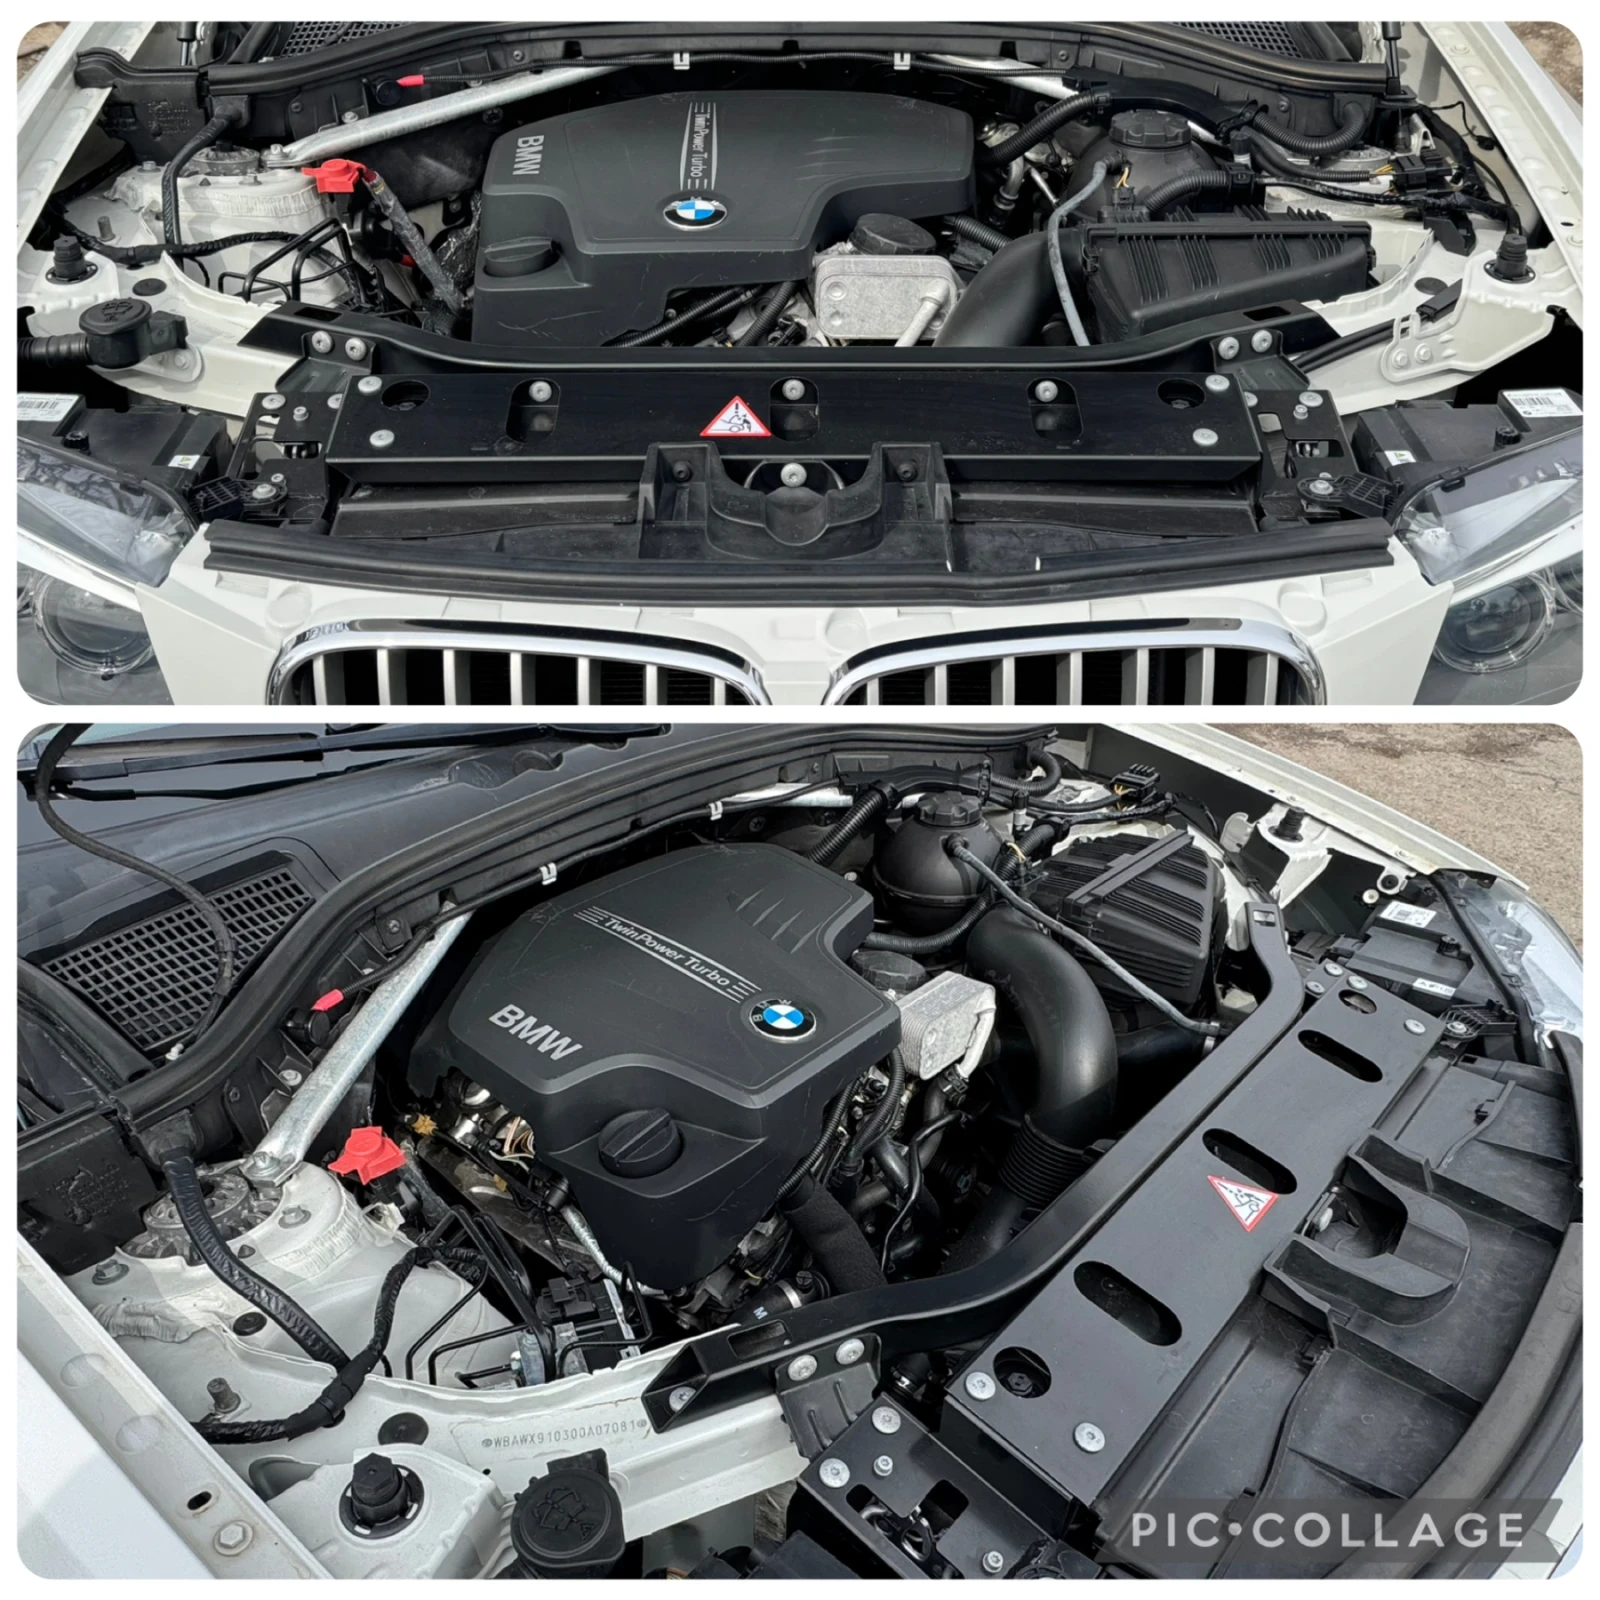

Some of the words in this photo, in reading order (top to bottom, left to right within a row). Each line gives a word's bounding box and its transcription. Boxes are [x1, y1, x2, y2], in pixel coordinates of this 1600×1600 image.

[691, 113, 710, 152] TwinPower
[512, 134, 545, 176] BMW
[690, 153, 708, 178] Turbo
[604, 916, 685, 961] TwinPower
[683, 956, 731, 988] Turbo
[488, 1003, 584, 1062] BMW
